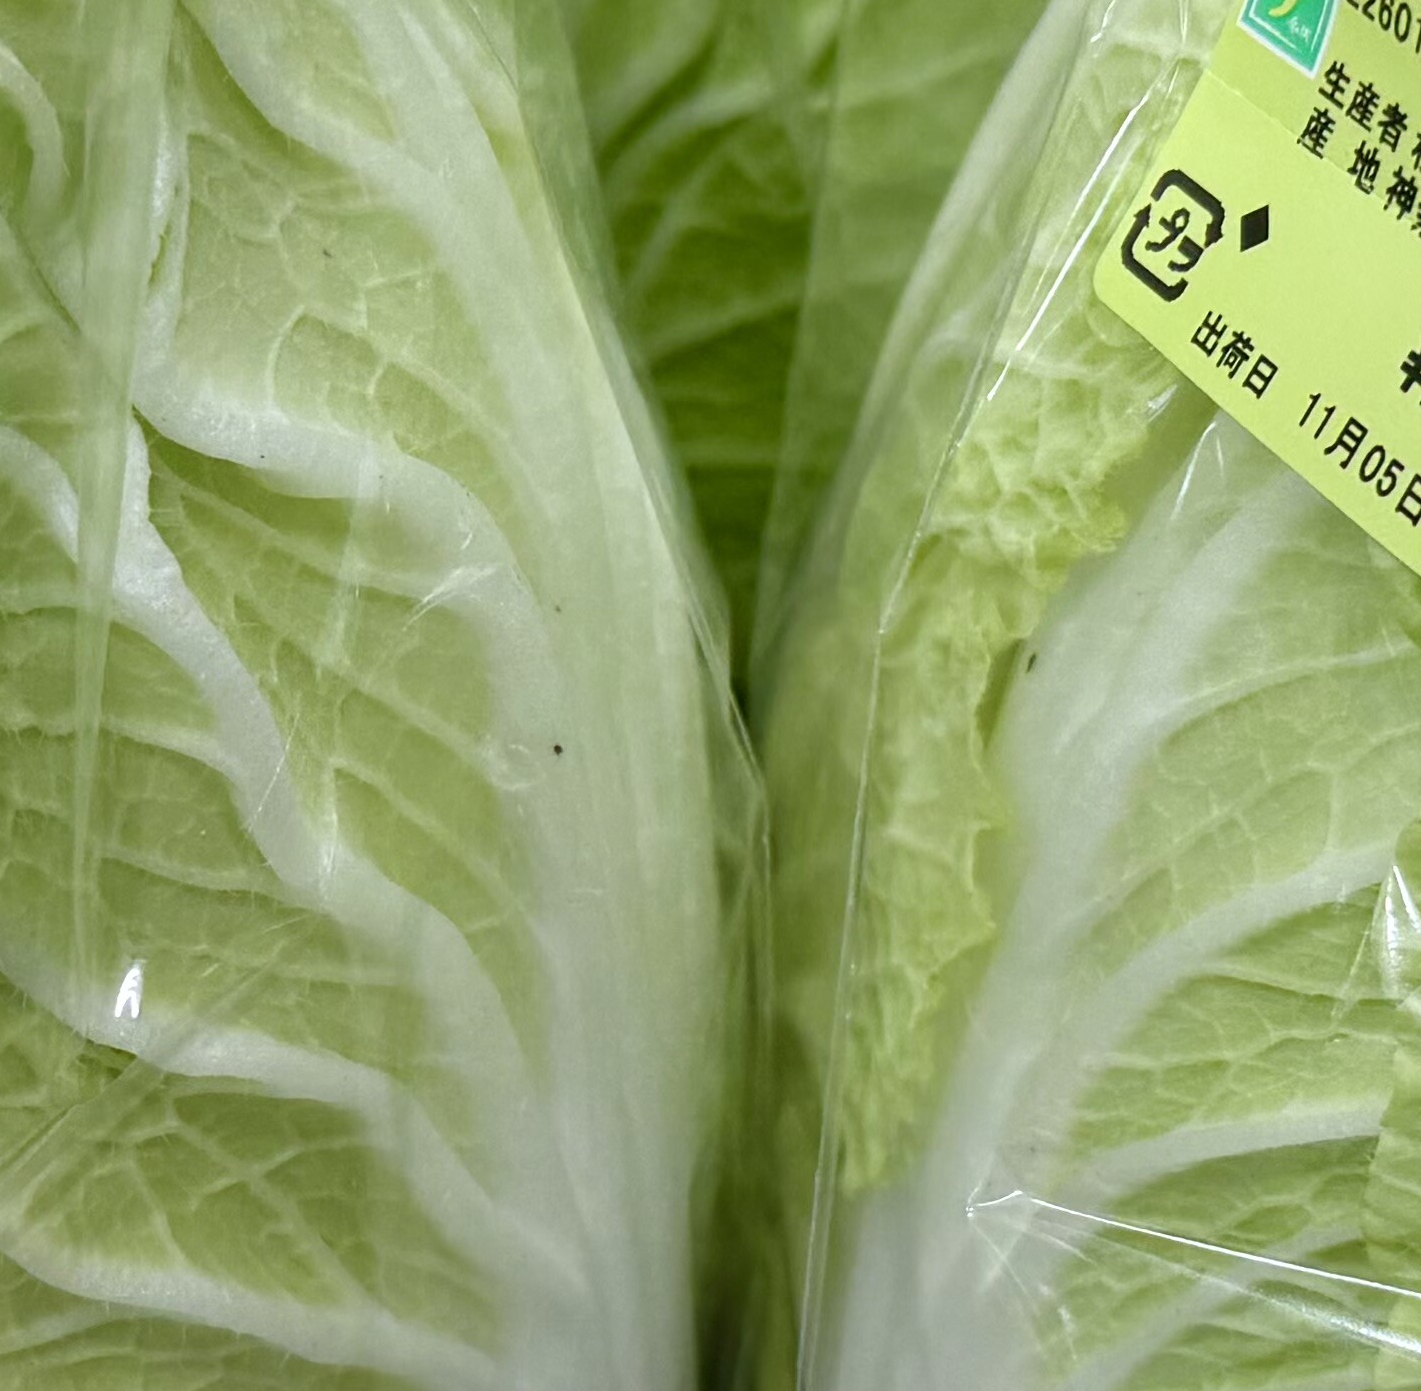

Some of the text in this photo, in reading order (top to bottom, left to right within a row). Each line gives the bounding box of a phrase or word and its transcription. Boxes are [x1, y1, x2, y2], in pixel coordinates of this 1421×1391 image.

[1318, 61, 1408, 152] 生産者
[1190, 310, 1279, 400] 出荷日
